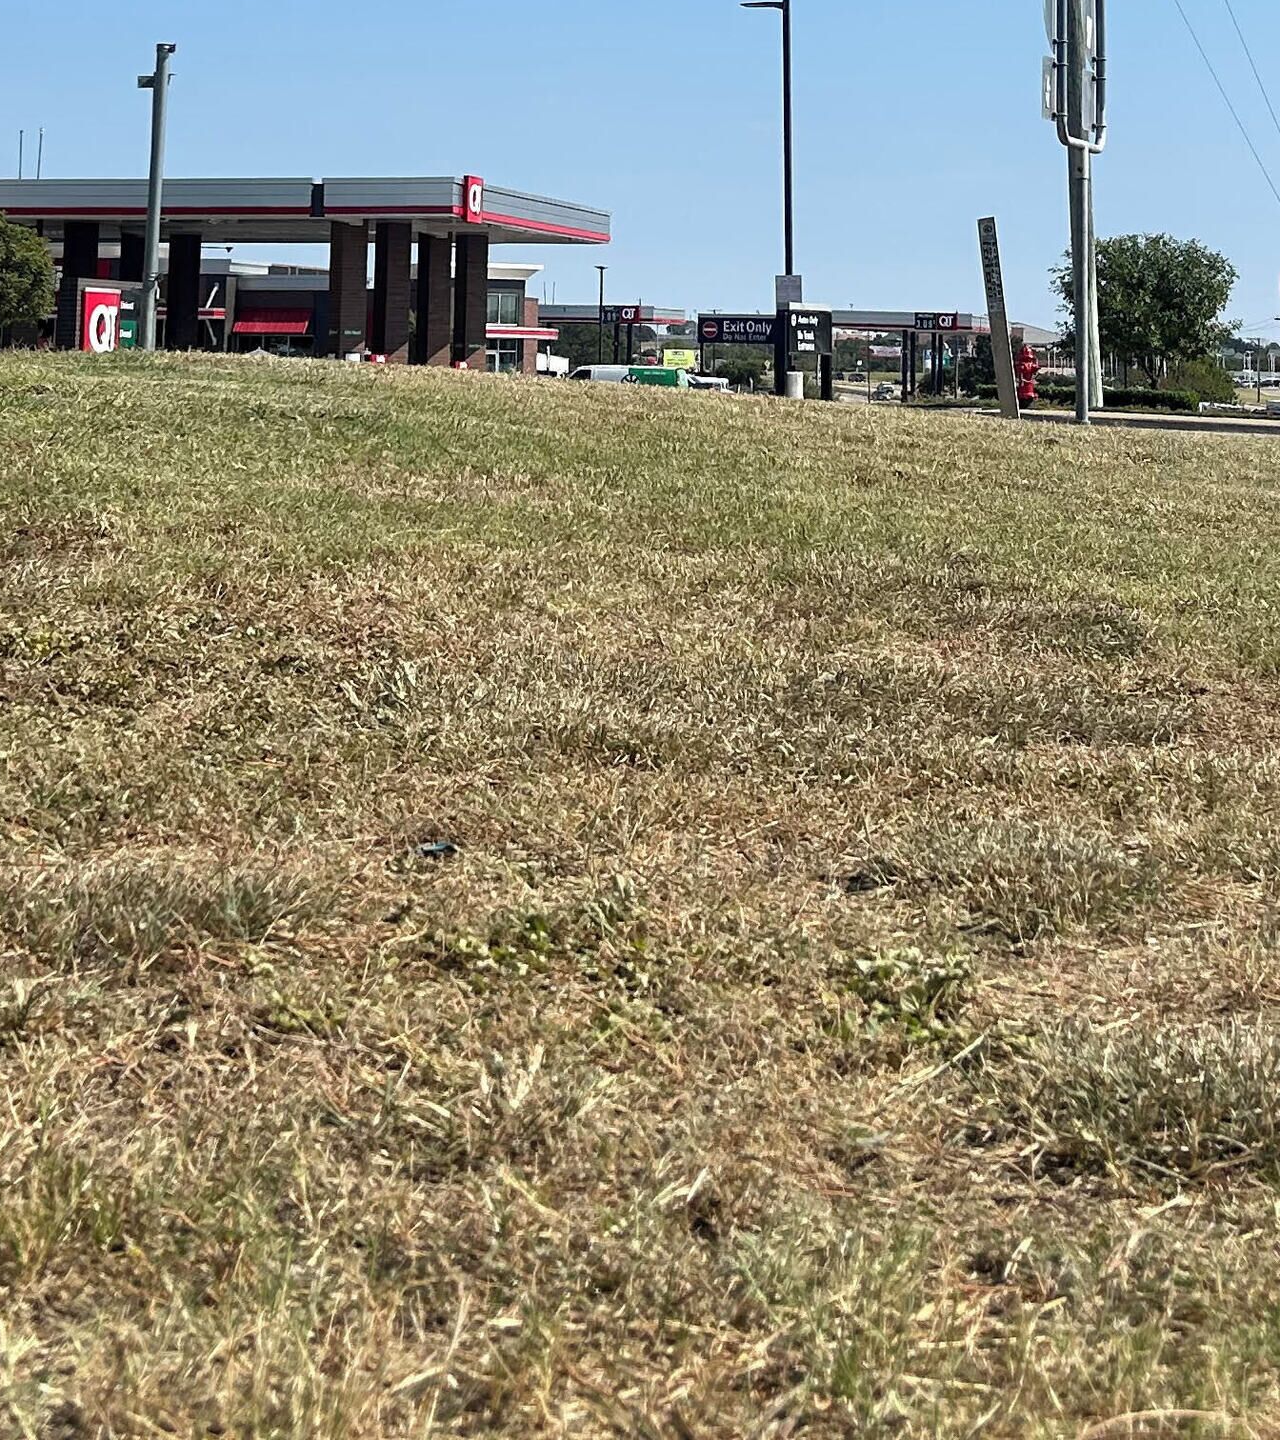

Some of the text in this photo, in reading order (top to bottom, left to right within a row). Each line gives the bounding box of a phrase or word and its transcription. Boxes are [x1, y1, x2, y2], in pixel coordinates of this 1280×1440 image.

[622, 308, 635, 319] QT
[723, 320, 772, 335] Exit Only
[939, 315, 953, 327] QT
[89, 304, 118, 354] QT
